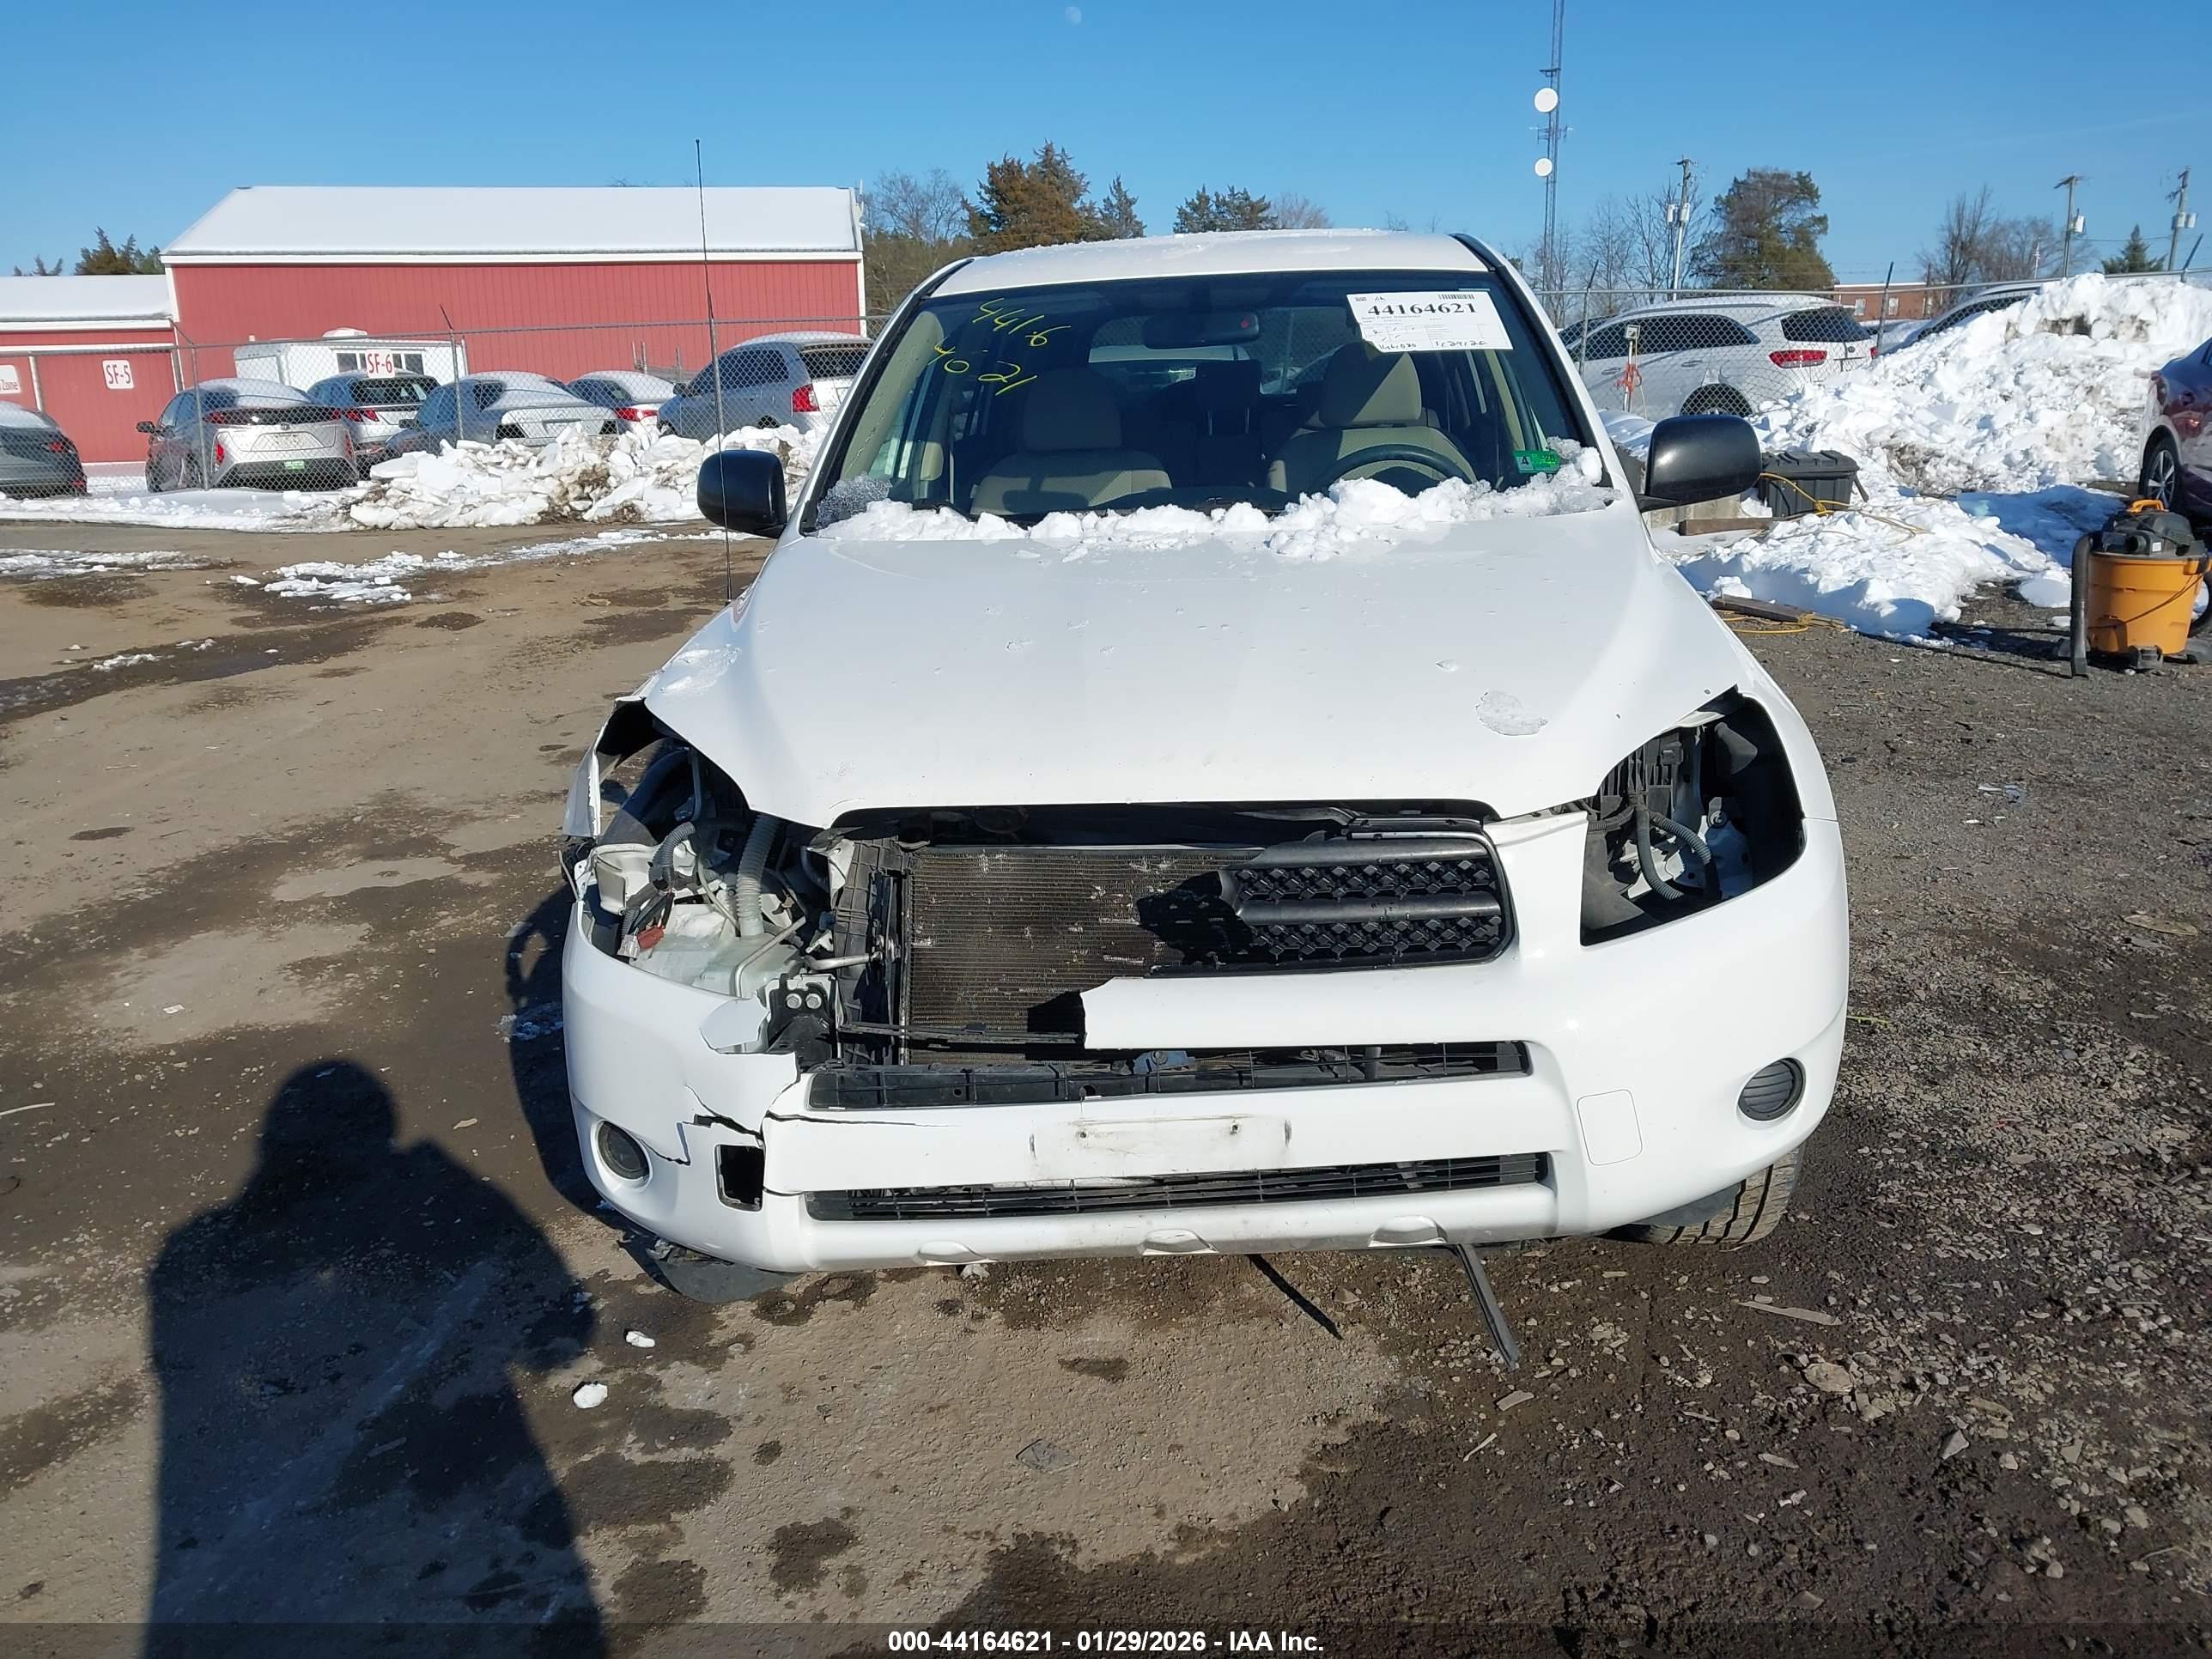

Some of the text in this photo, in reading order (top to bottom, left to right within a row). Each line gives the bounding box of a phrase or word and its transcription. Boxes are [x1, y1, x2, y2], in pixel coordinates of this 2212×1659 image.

[1368, 303, 1477, 316] 44164621
[368, 353, 392, 374] SF-6
[106, 364, 131, 384] SF-5
[1522, 456, 1529, 465] 4
